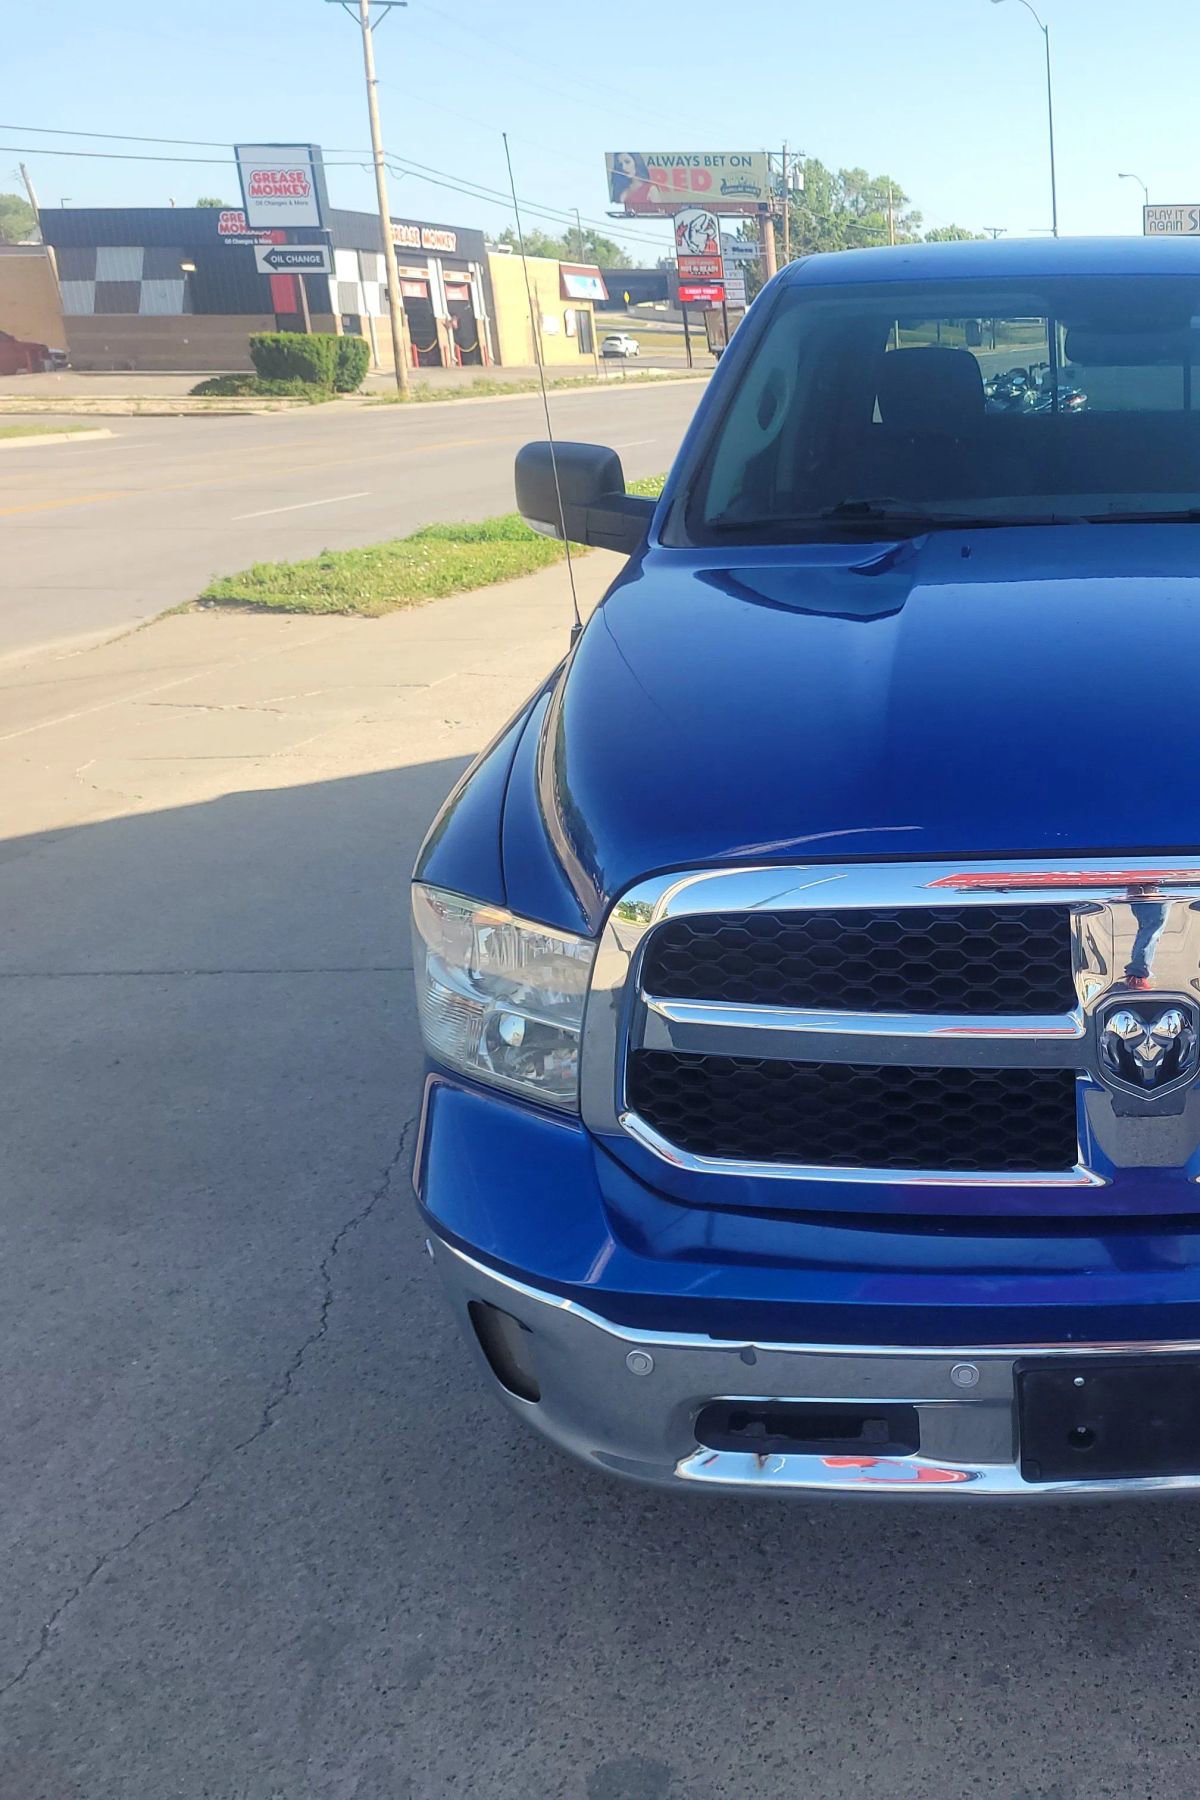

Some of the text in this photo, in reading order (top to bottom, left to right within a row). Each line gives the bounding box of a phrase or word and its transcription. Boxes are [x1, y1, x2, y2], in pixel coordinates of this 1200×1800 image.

[647, 155, 752, 167] ALWAYS BET ON
[252, 171, 304, 184] GREASE
[650, 169, 712, 192] RED
[250, 184, 309, 196] MONKEY
[220, 212, 245, 223] GRE
[1147, 210, 1184, 220] PLAY IT
[1149, 220, 1183, 231] AGAIN
[286, 255, 321, 263] CHANGE
